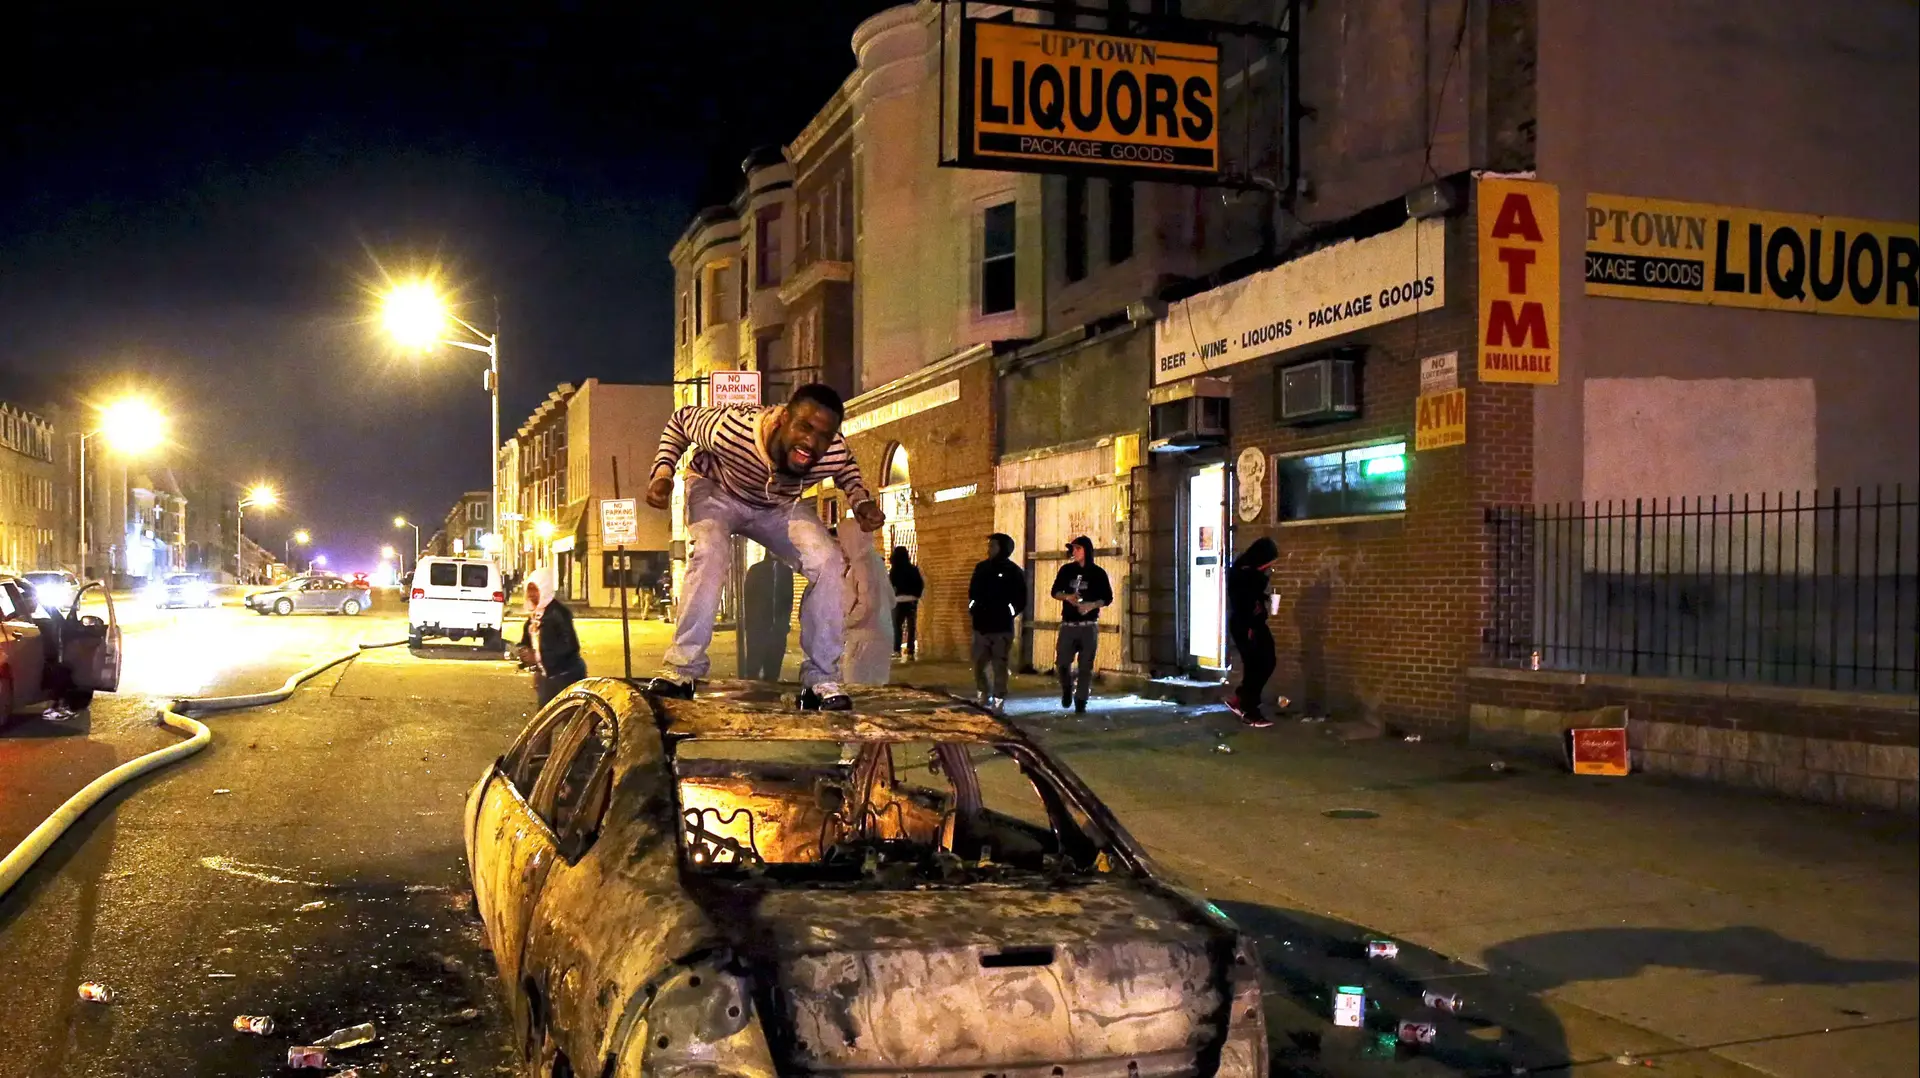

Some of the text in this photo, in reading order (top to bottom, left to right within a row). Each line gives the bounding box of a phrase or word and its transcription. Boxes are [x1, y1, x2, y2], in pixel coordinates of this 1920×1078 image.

[1040, 33, 1157, 66] UPTOWN
[980, 57, 1214, 142] LIQUORS
[1020, 137, 1175, 162] PACKAGE GOODS
[1586, 207, 1707, 250] PTOWN
[1485, 193, 1550, 349] ATM
[1643, 261, 1701, 286] GOODS
[1714, 219, 1919, 307] LIQUOR
[1160, 276, 1435, 371] BEER WINE LIQUORS PACKAGE GOODS
[1431, 358, 1445, 369] NO
[1485, 353, 1551, 373] AVAILABLE
[716, 384, 756, 392] PARKING
[1418, 391, 1464, 431] ATM
